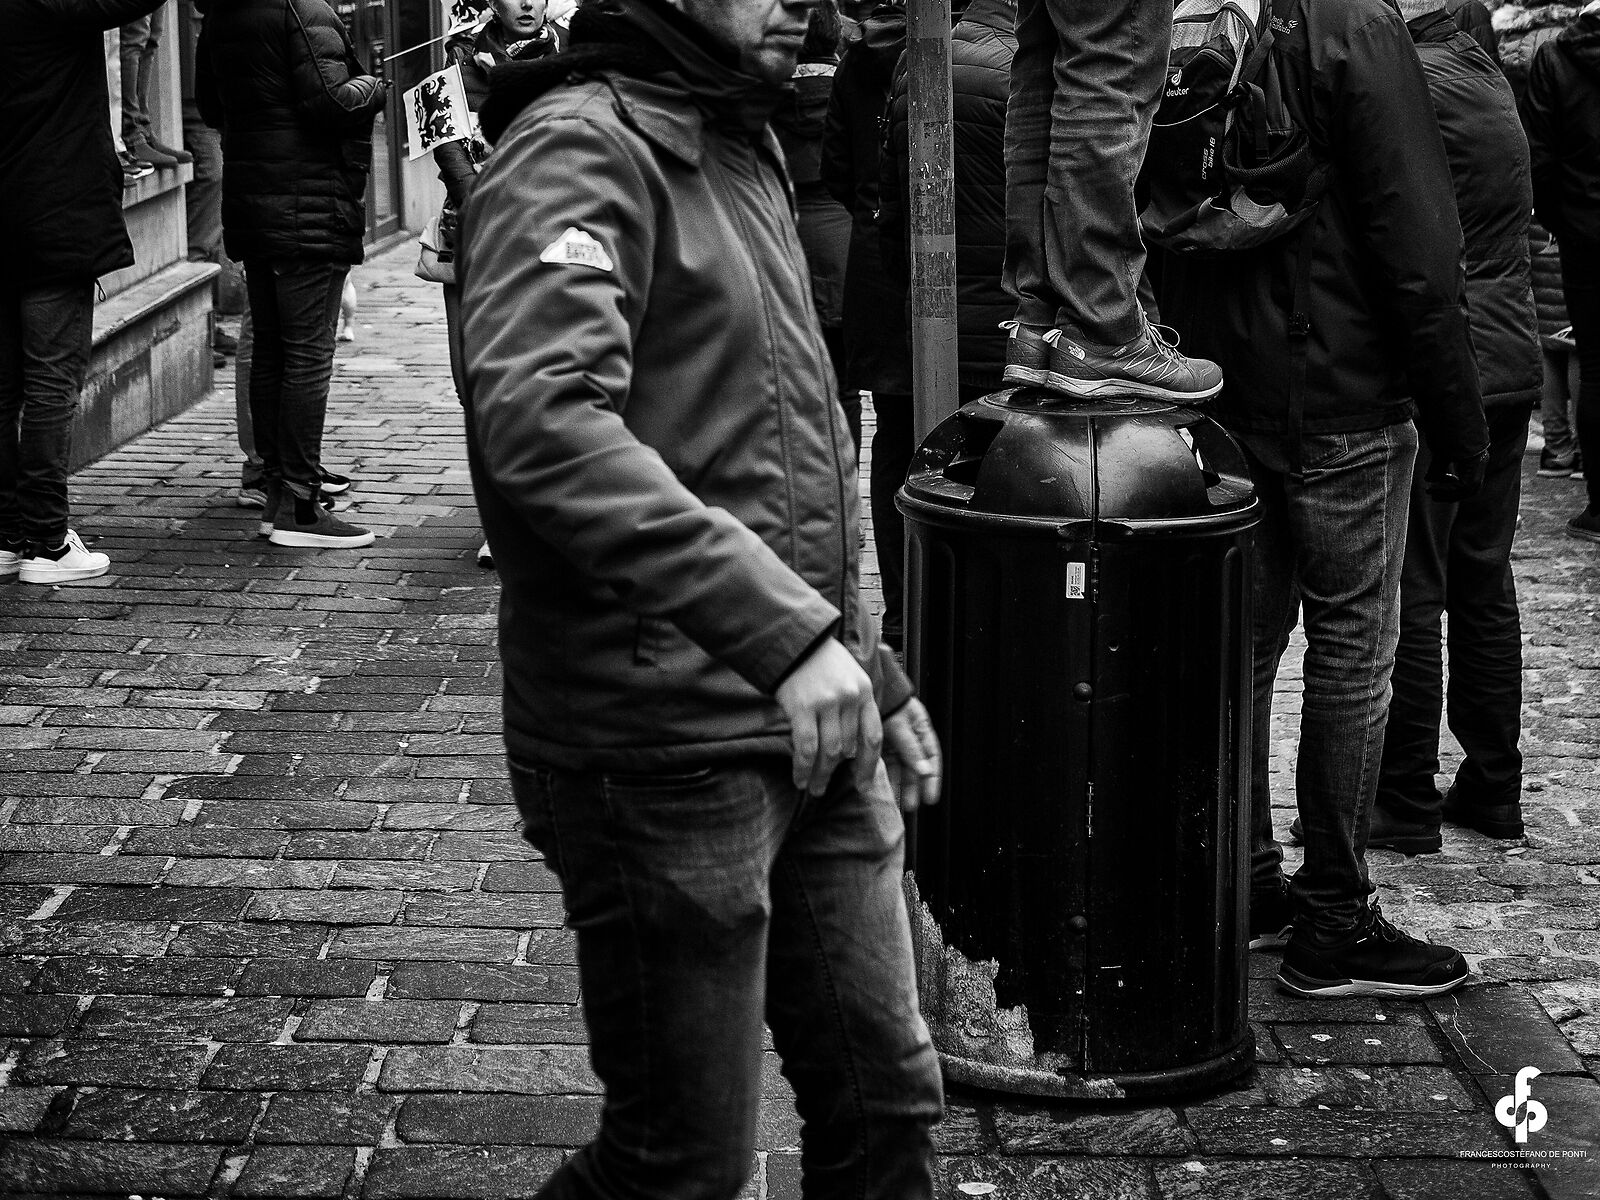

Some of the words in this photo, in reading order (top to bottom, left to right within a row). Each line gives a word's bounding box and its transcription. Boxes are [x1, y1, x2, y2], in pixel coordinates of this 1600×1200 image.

[1166, 87, 1189, 97] deuter
[1201, 149, 1209, 180] cross
[1207, 148, 1215, 168] bike
